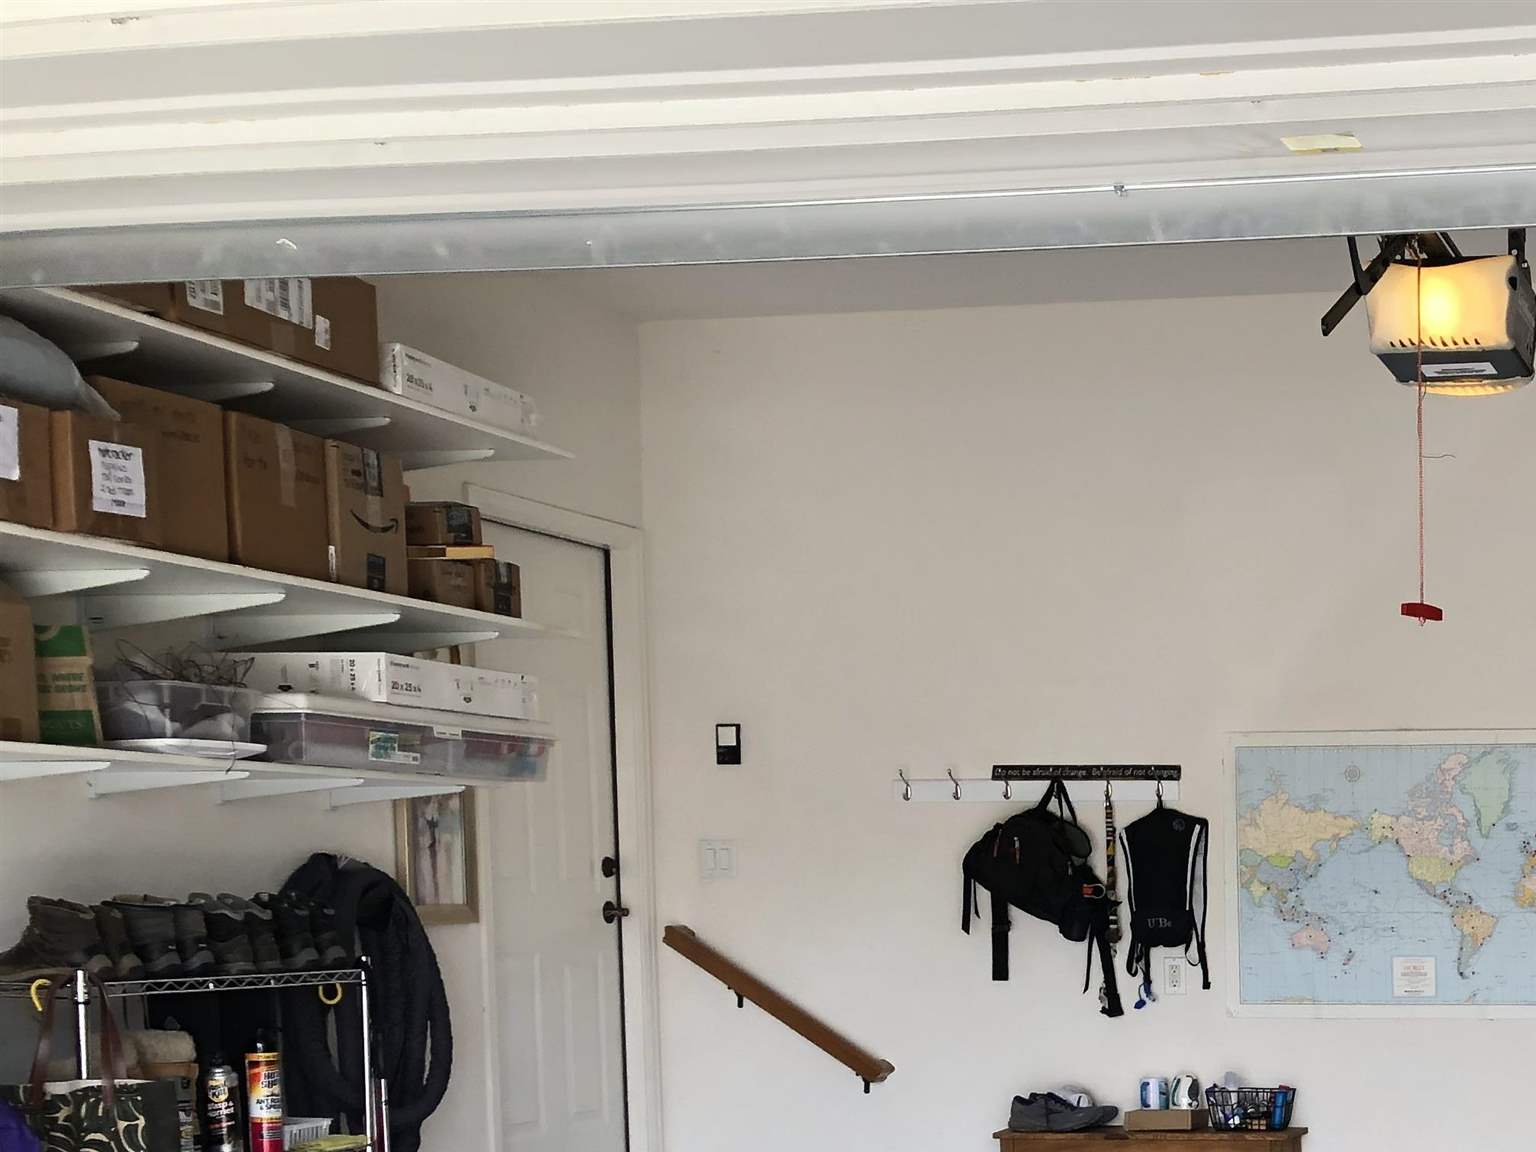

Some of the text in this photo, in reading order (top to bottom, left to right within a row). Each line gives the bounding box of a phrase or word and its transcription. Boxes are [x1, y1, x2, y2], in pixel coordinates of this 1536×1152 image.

[391, 680, 400, 690] 20
[404, 682, 412, 692] 25
[1008, 768, 1020, 776] not
[1022, 768, 1032, 776] be
[1124, 768, 1132, 776] of
[1133, 768, 1146, 776] not
